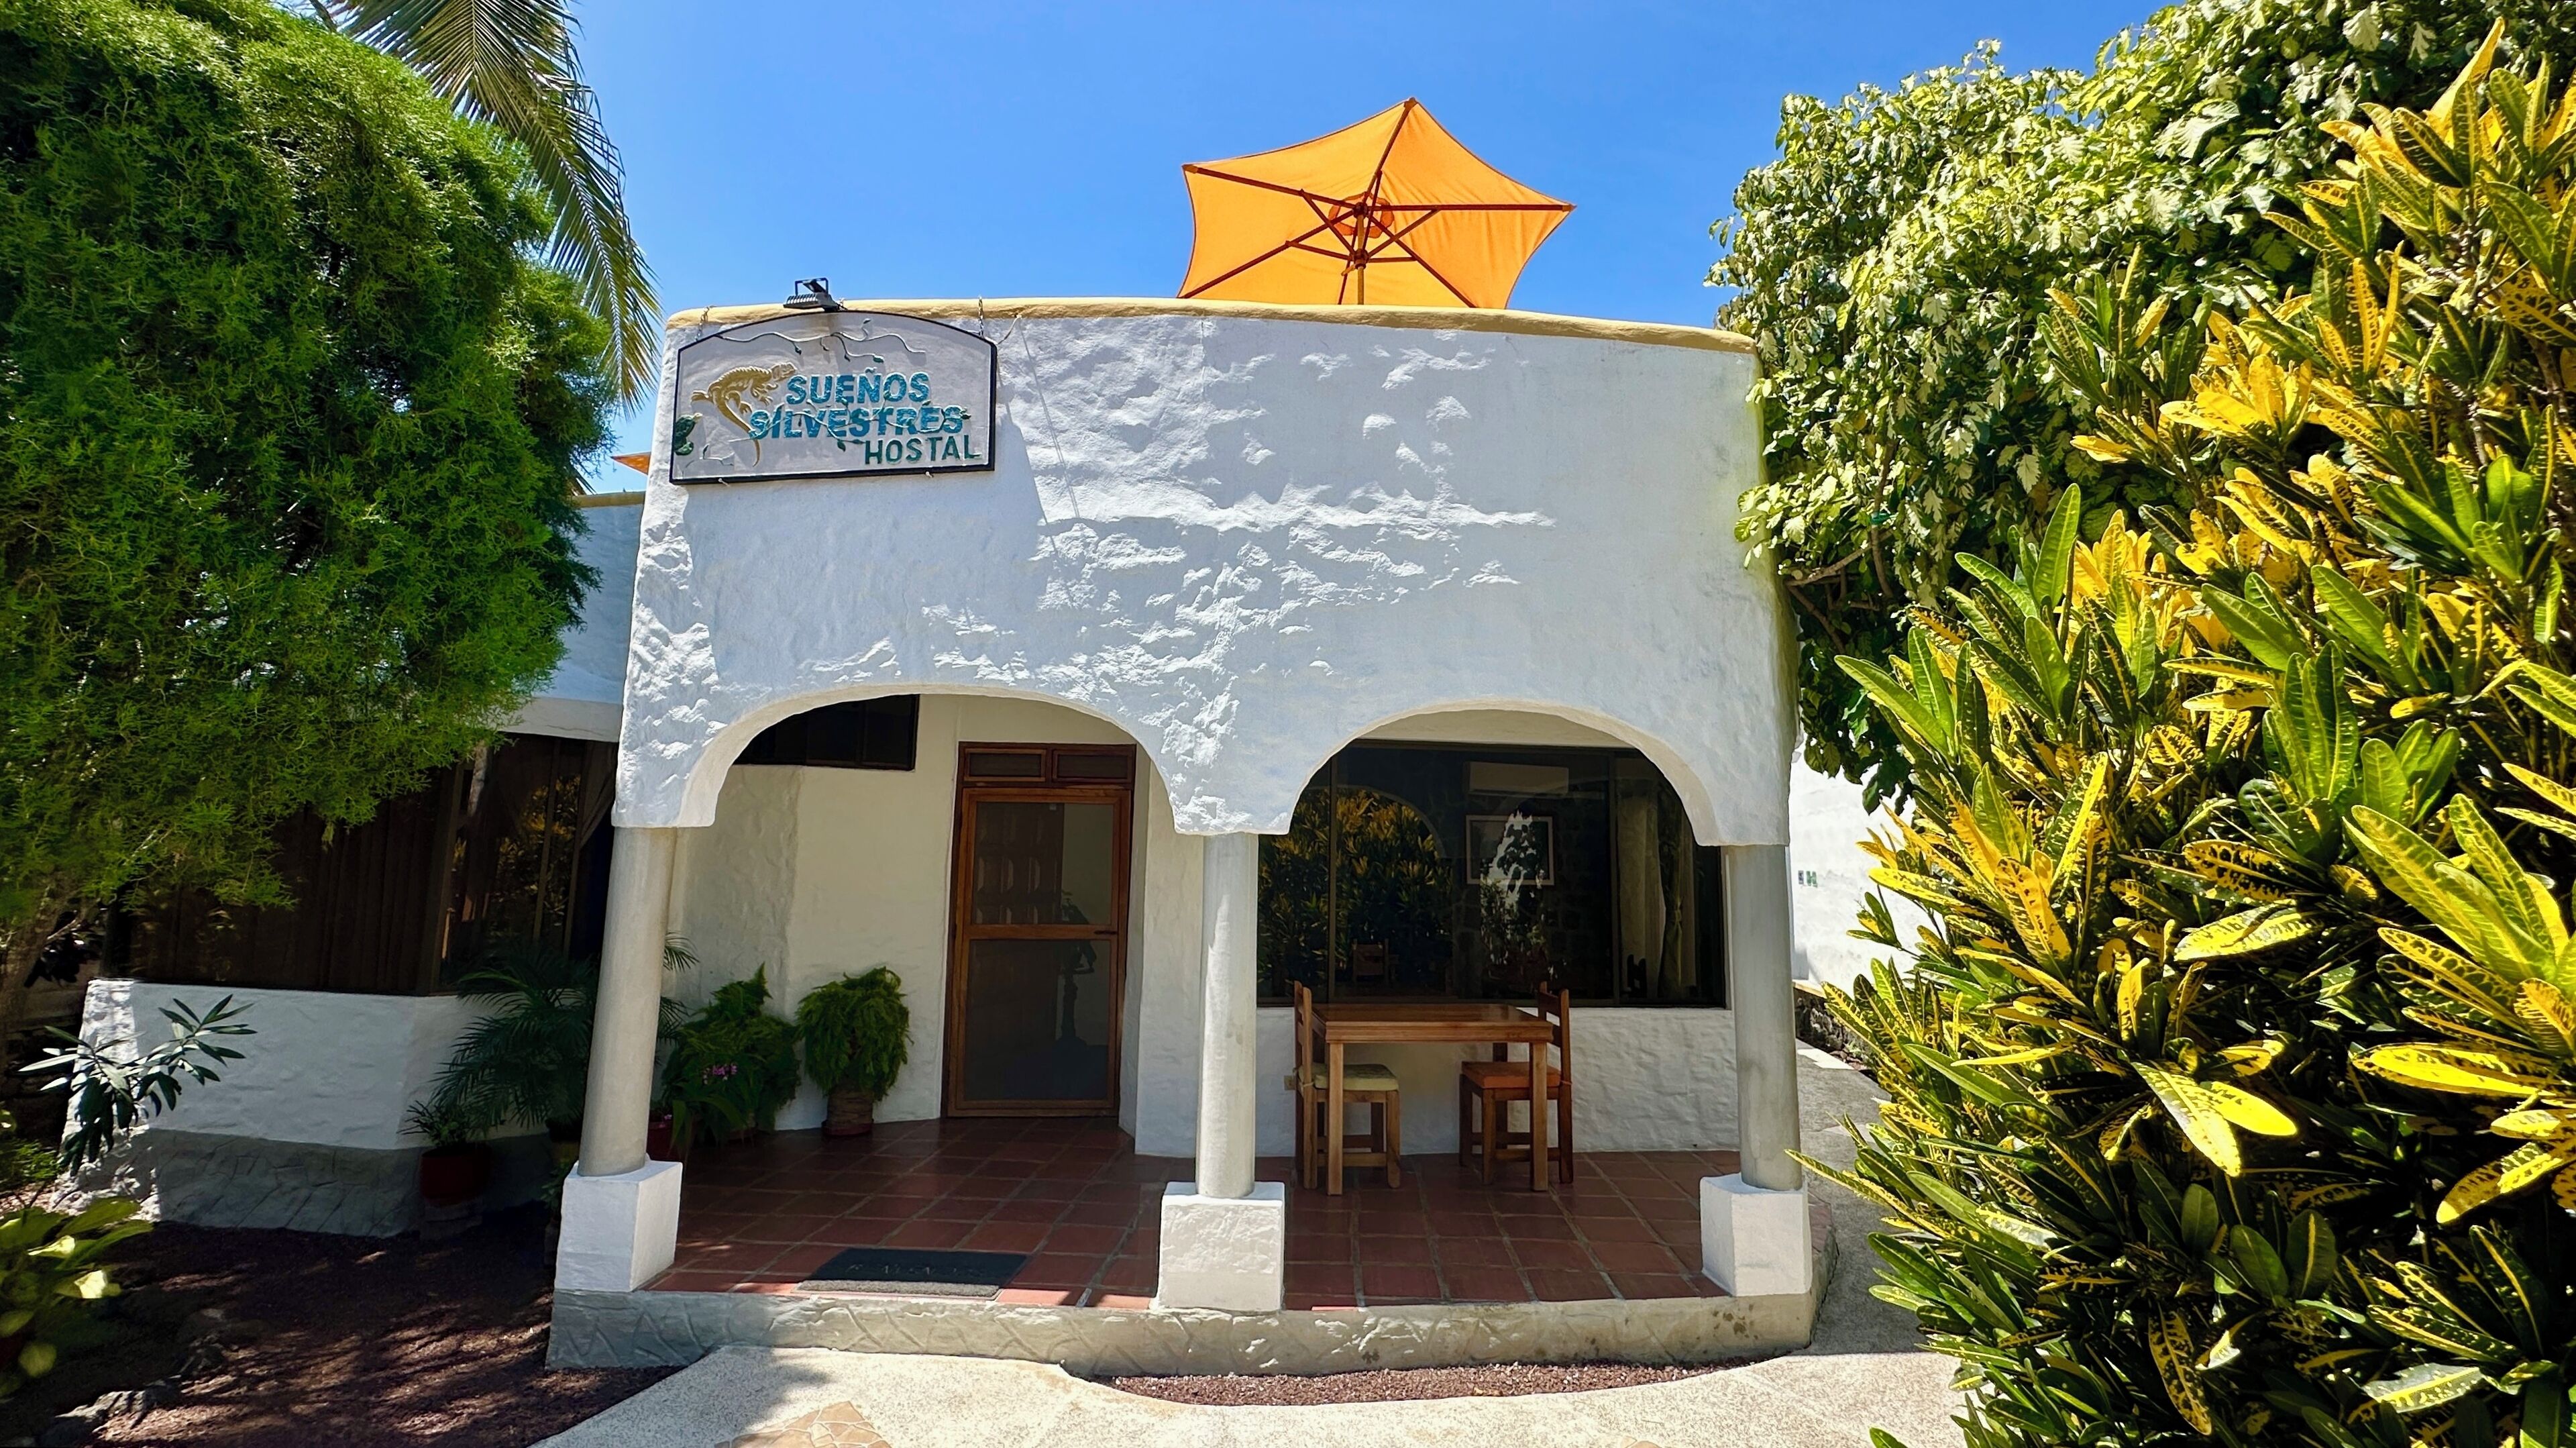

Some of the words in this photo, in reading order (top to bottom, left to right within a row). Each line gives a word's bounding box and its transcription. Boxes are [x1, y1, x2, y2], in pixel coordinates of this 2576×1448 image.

[786, 367, 930, 404] SUEÑOS
[749, 405, 965, 439] SILVESTRES
[865, 435, 982, 465] HOSTAL
